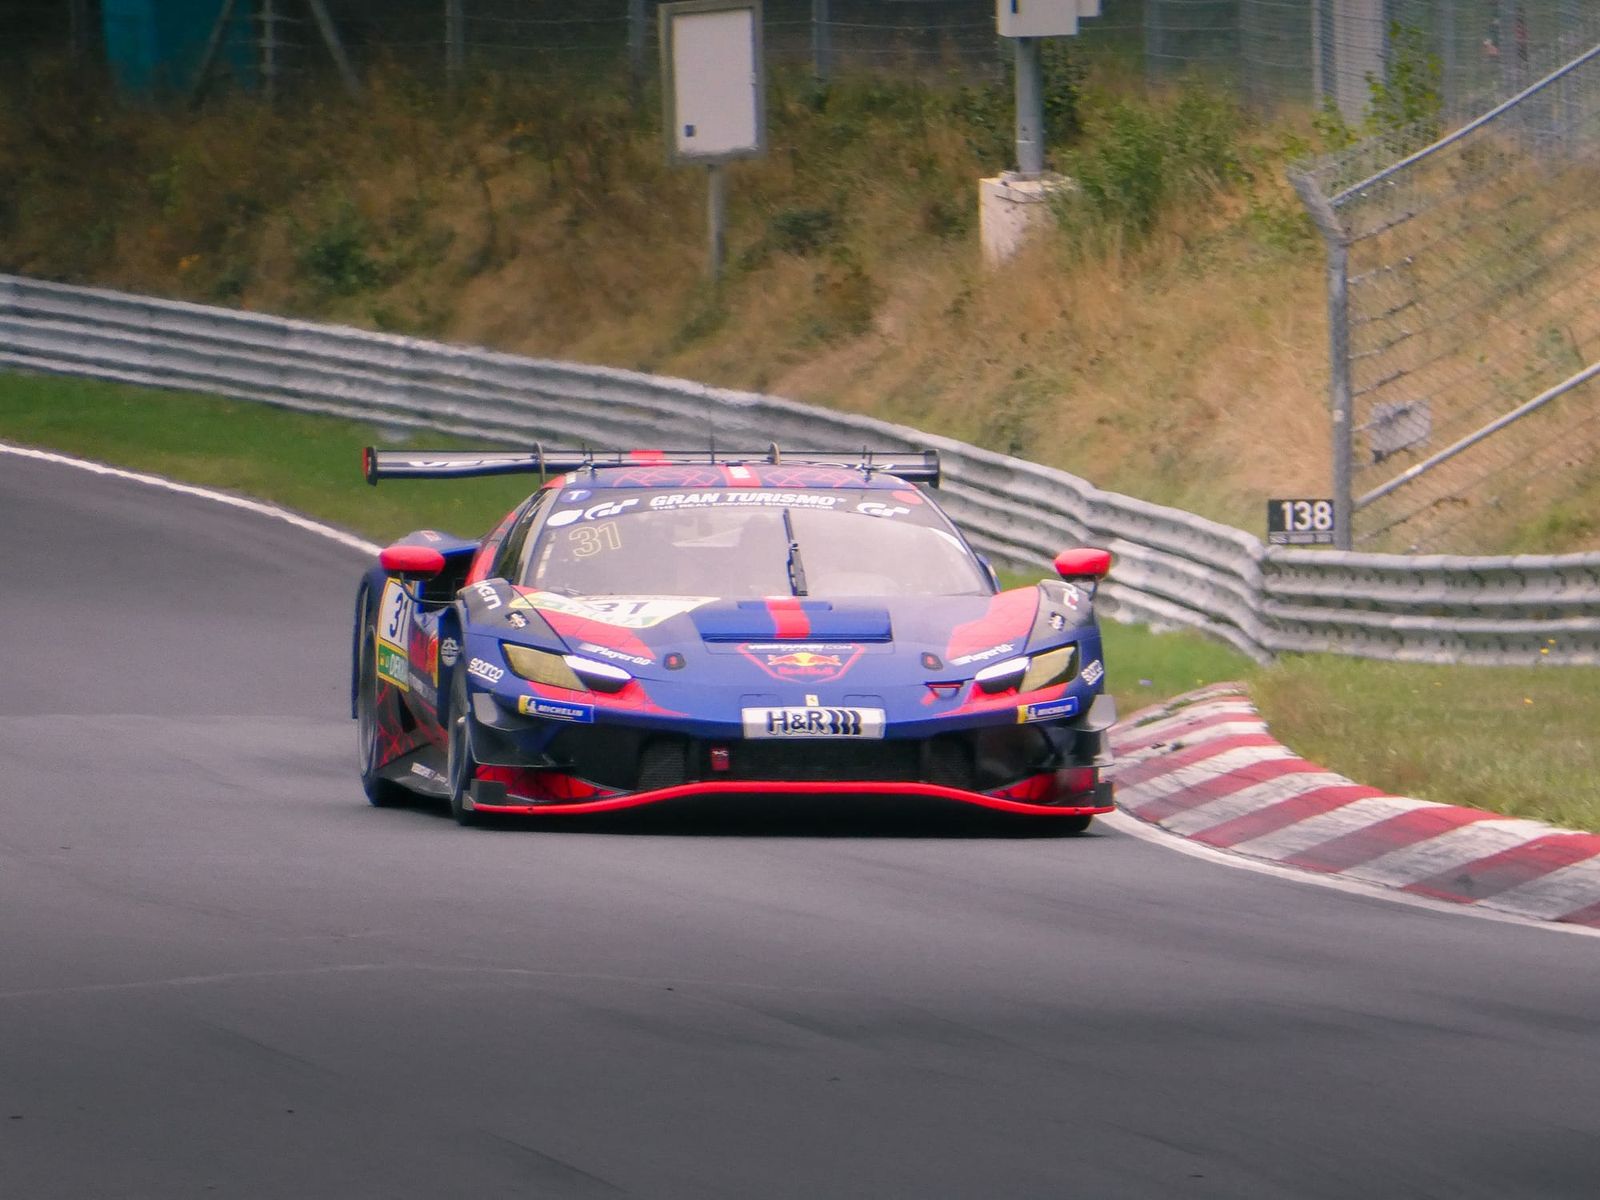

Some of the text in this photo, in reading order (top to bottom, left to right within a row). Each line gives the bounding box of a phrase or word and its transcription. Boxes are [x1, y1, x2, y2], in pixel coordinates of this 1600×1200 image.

[649, 492, 837, 507] GRAN TURISMO
[1281, 500, 1333, 531] 138
[568, 521, 622, 557] 31
[390, 593, 409, 642] 31
[593, 602, 649, 615] 31
[538, 705, 584, 717] MICHELIN
[766, 710, 830, 736] H&R
